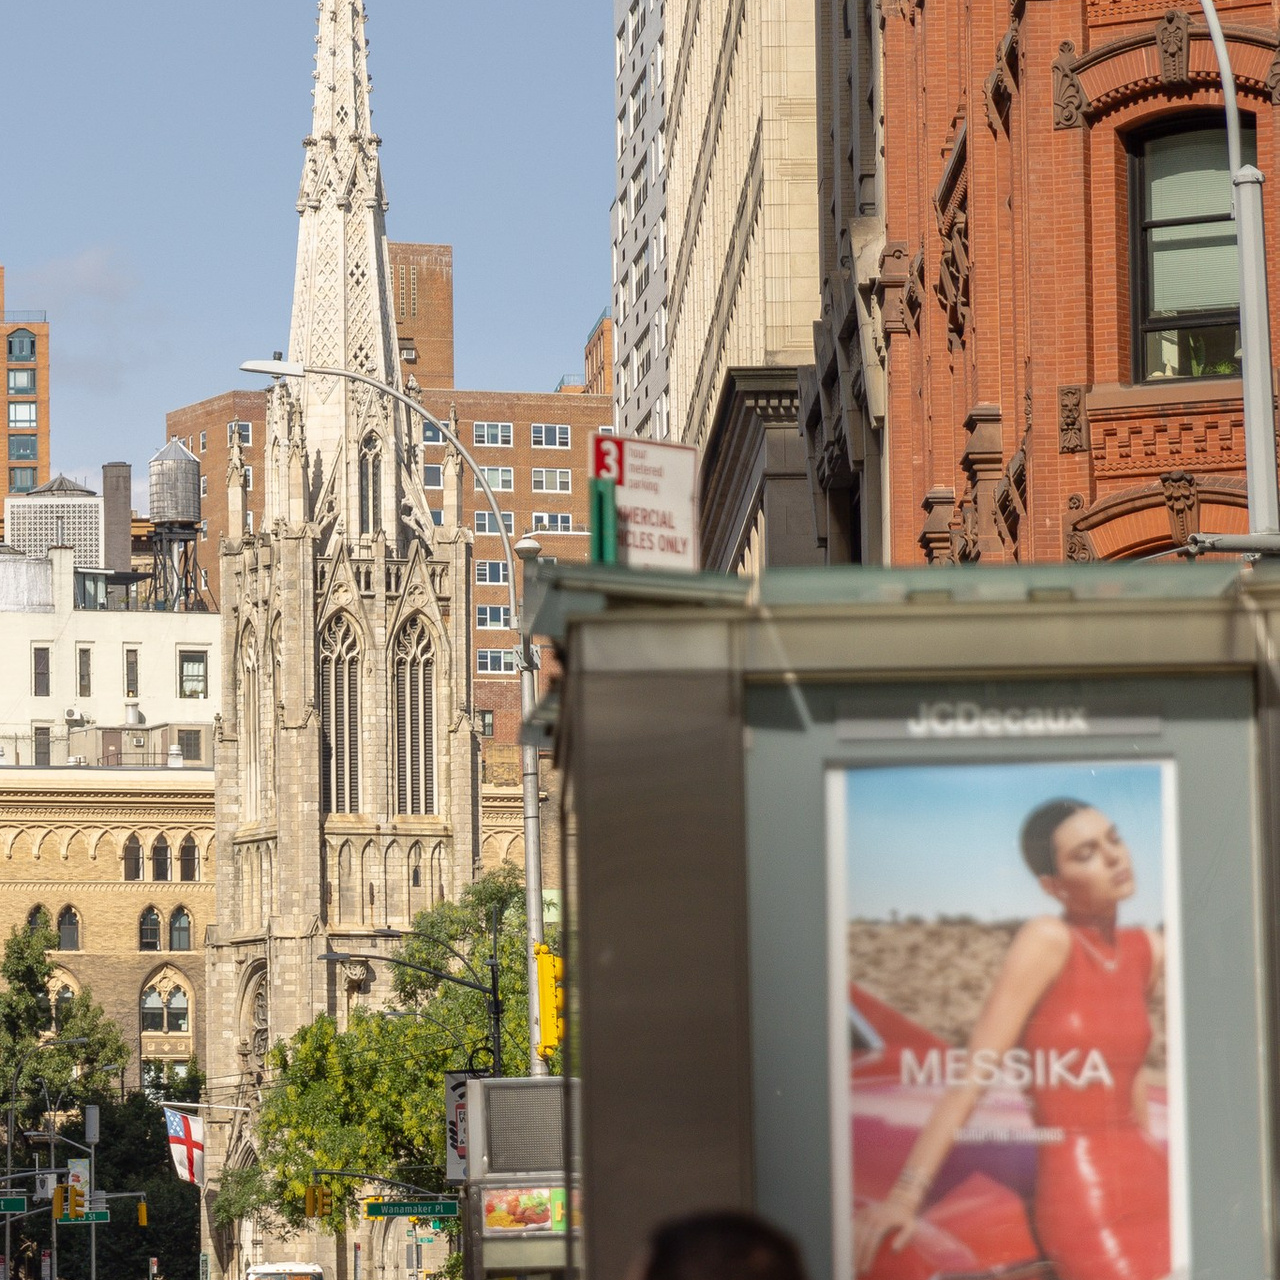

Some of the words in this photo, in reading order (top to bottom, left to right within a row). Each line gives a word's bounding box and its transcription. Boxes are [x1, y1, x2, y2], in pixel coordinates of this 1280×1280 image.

[599, 440, 619, 479] 3
[629, 463, 663, 477] metered
[658, 534, 687, 554] ONLY
[907, 701, 1089, 737] JCDecaux
[899, 1047, 1116, 1089] MESSIKA
[380, 1205, 432, 1214] Wanamaker
[435, 1204, 444, 1213] Pl
